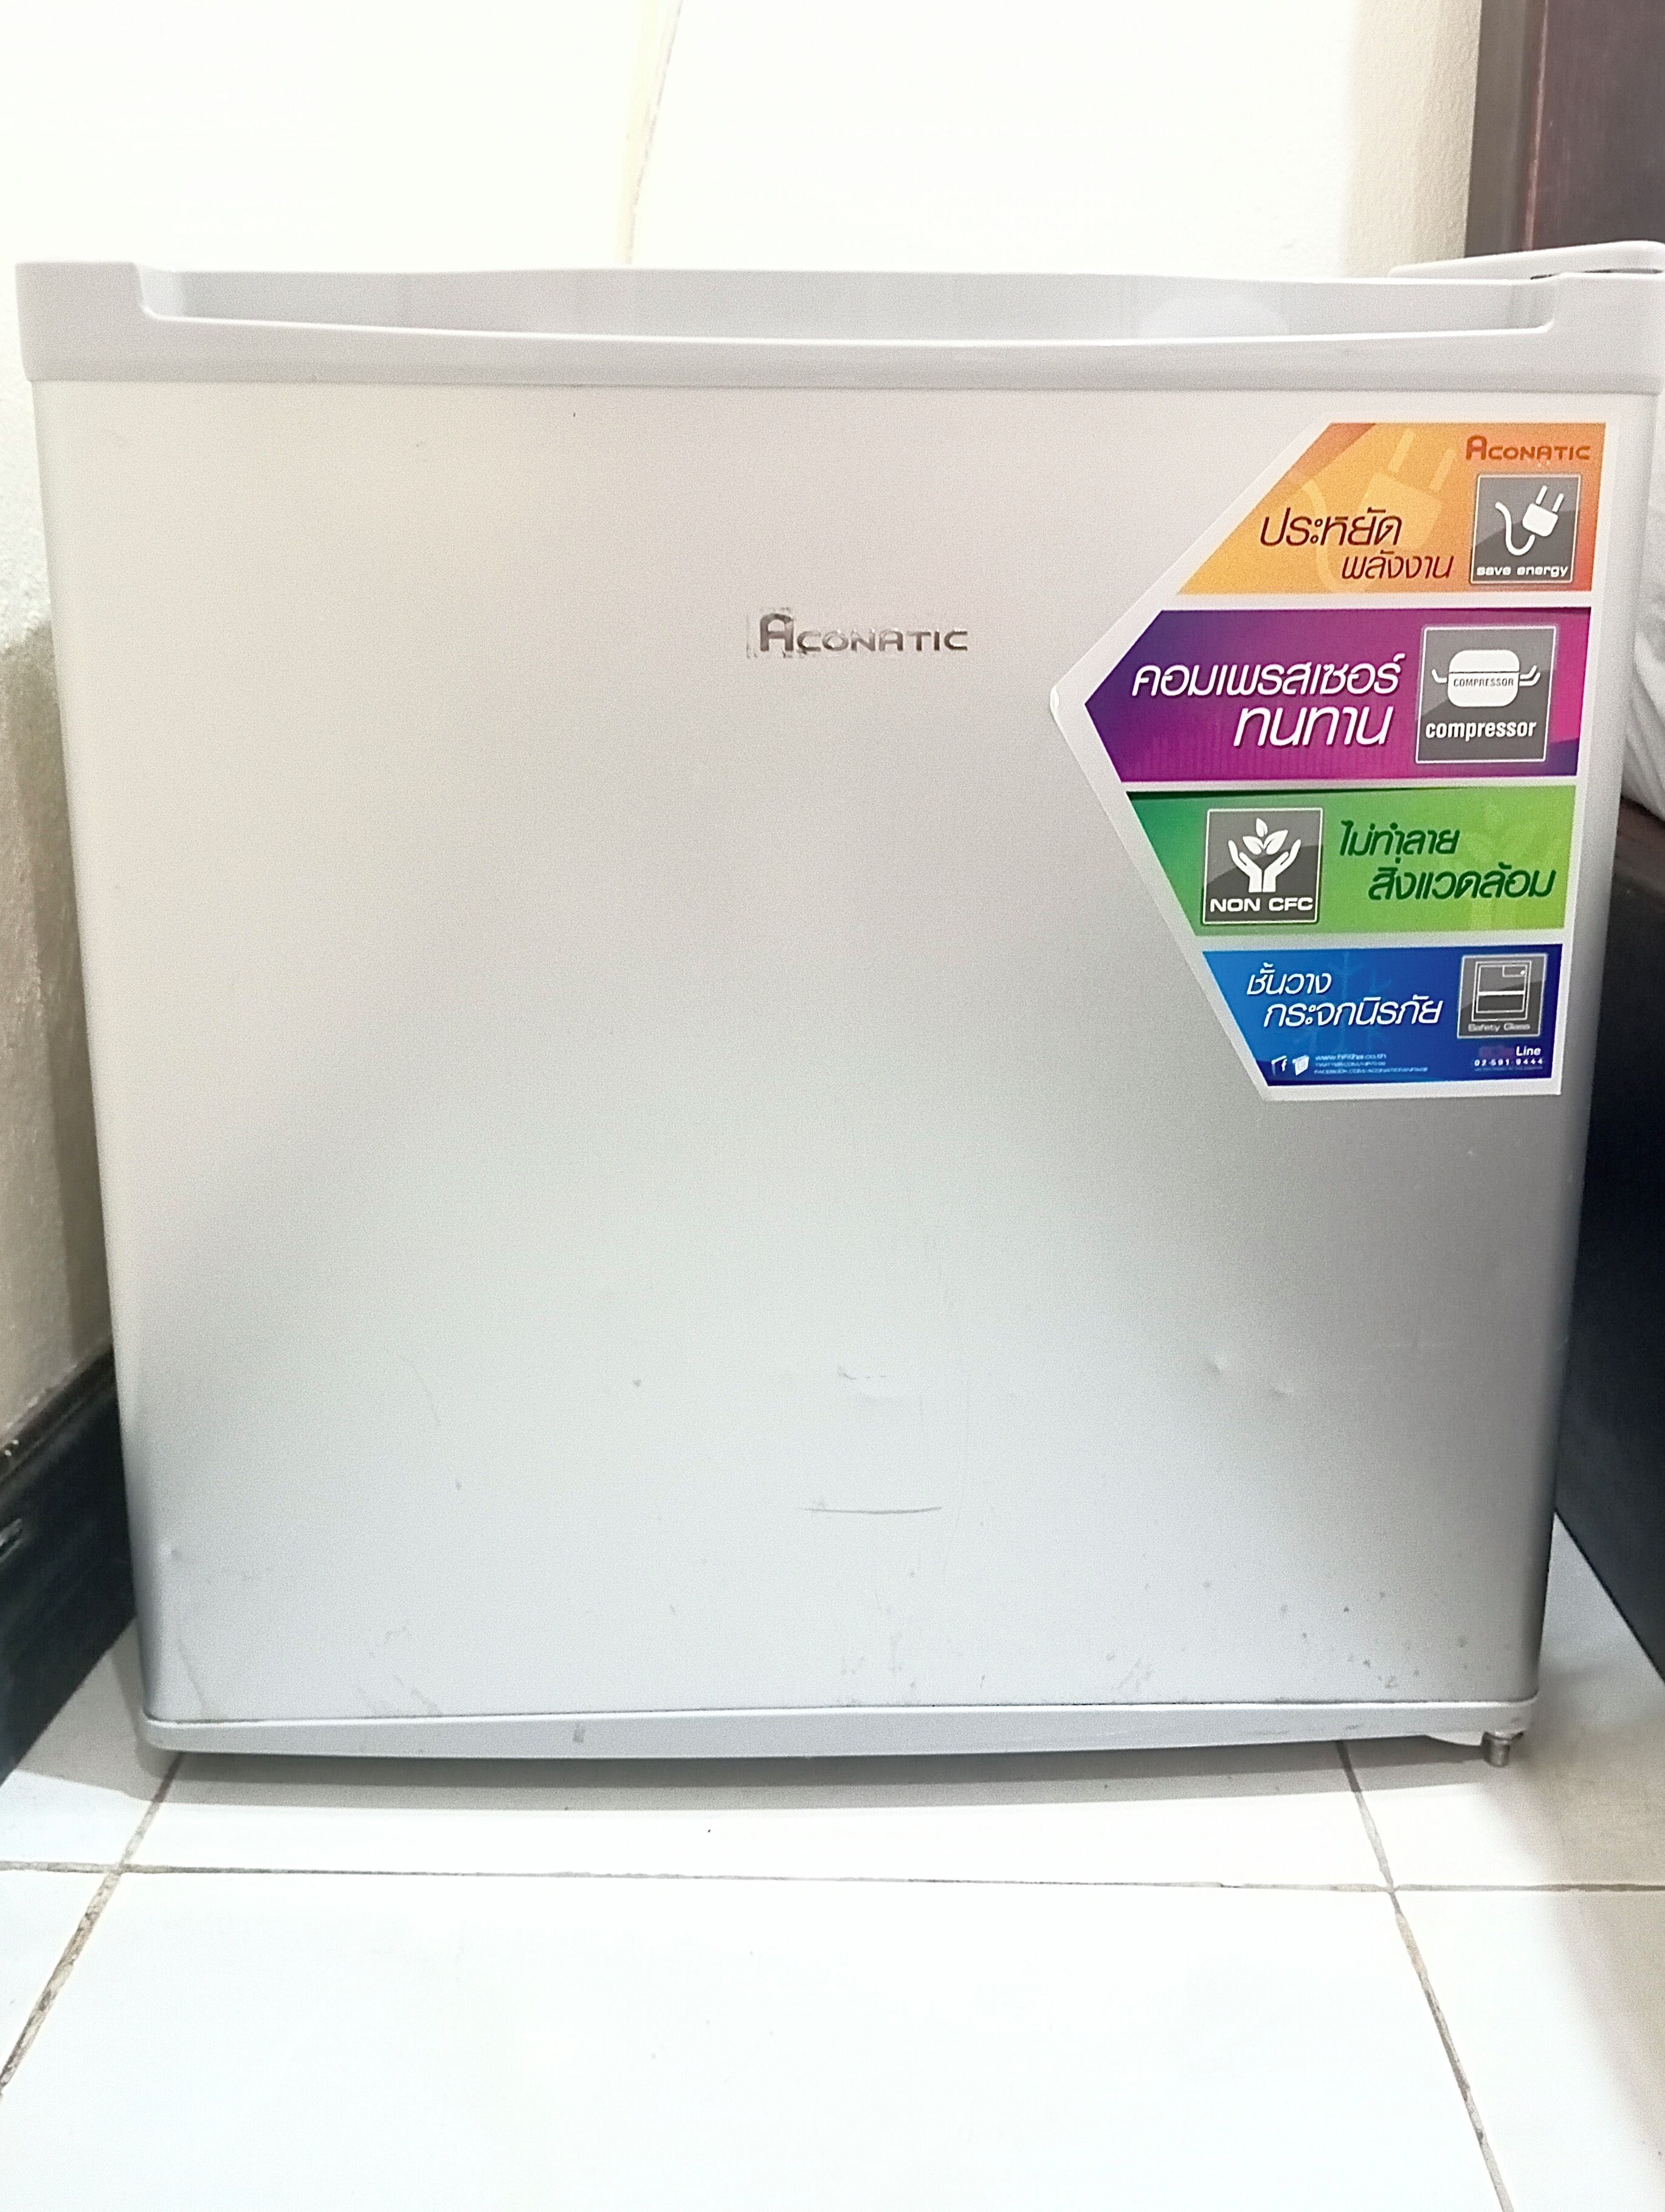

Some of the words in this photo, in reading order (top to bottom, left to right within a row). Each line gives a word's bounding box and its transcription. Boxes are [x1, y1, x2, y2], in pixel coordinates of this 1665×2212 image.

[1260, 507, 1402, 546] ประหยัด
[1342, 549, 1454, 579] พลังงาน
[1477, 566, 1511, 576] save
[1517, 565, 1568, 578] energy
[1132, 653, 1405, 696] คอมเพรสเซอร์
[1453, 678, 1514, 687] COMPRESSOR
[1233, 707, 1394, 746] ทนทาน
[1425, 721, 1537, 742] compressor
[1339, 820, 1460, 856] ไม่ทำลาย
[1368, 857, 1556, 900] สิ่งแวดล้อม
[1210, 899, 1261, 913] NON
[1268, 897, 1313, 911] CFC
[1247, 963, 1332, 995] ชั้นวาง
[1264, 995, 1443, 1028] กระจกนิรภัย
[1516, 1046, 1541, 1056] Line
